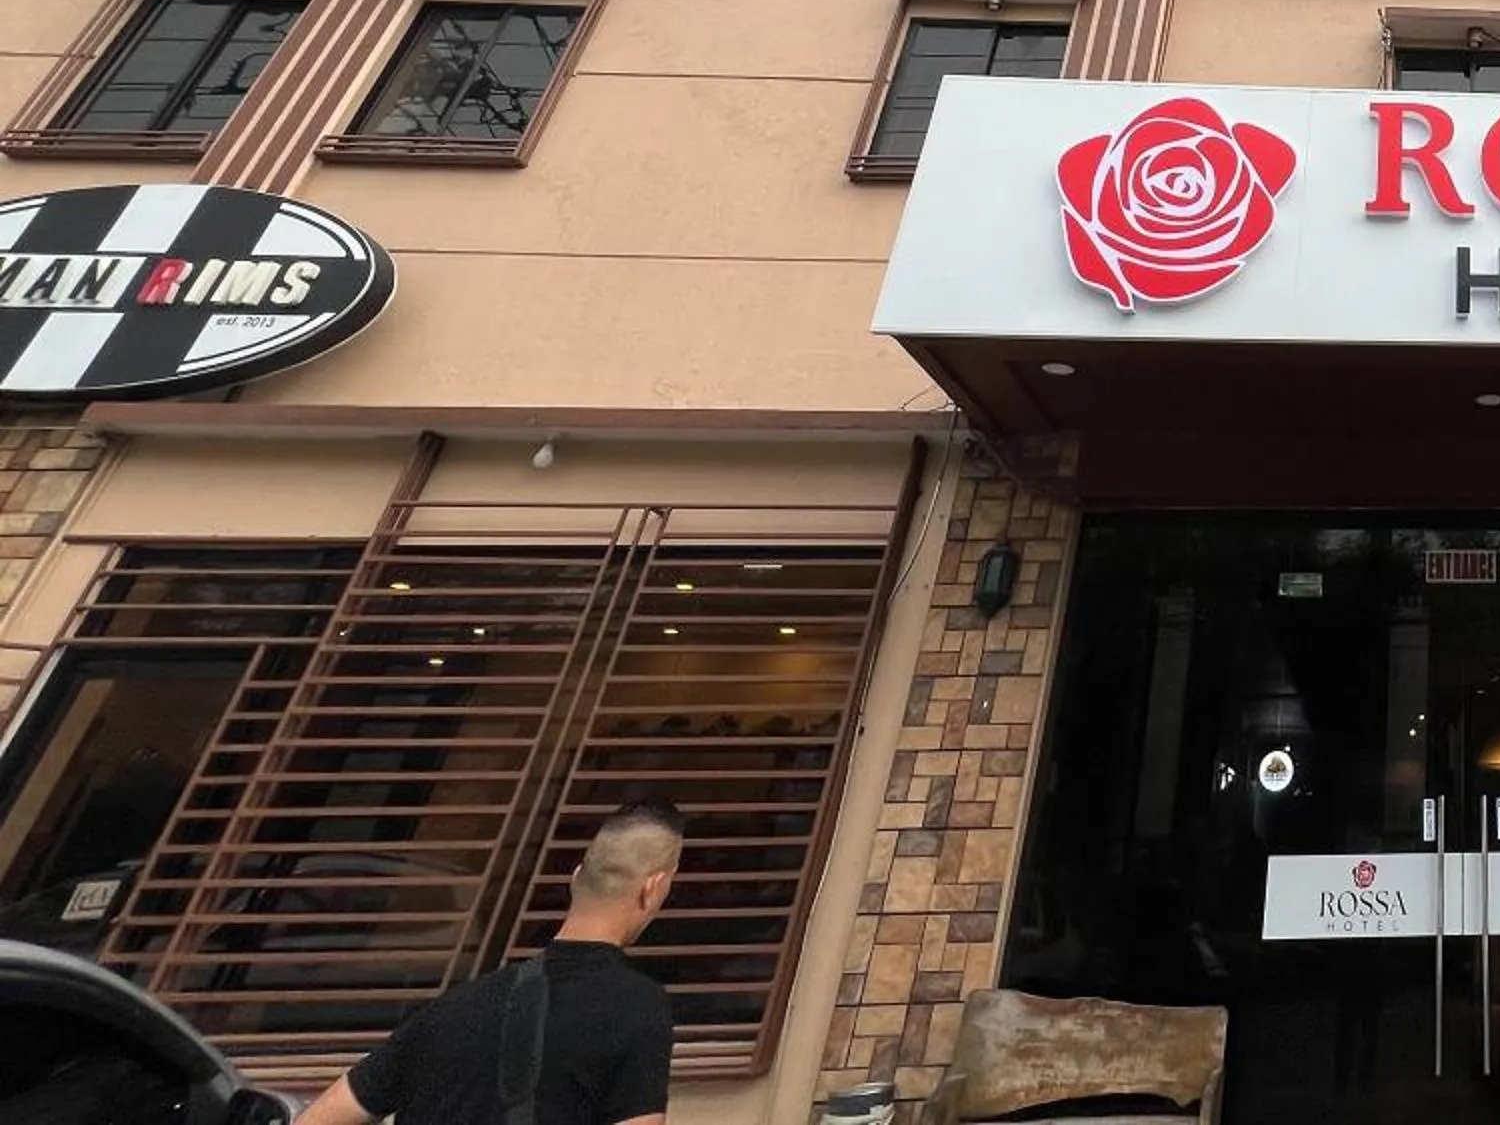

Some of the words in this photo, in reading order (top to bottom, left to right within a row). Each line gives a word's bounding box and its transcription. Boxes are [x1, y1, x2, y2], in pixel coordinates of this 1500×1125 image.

[137, 258, 321, 308] RIMS
[1319, 889, 1408, 919] ROSSA
[1327, 921, 1401, 932] HOTEL
